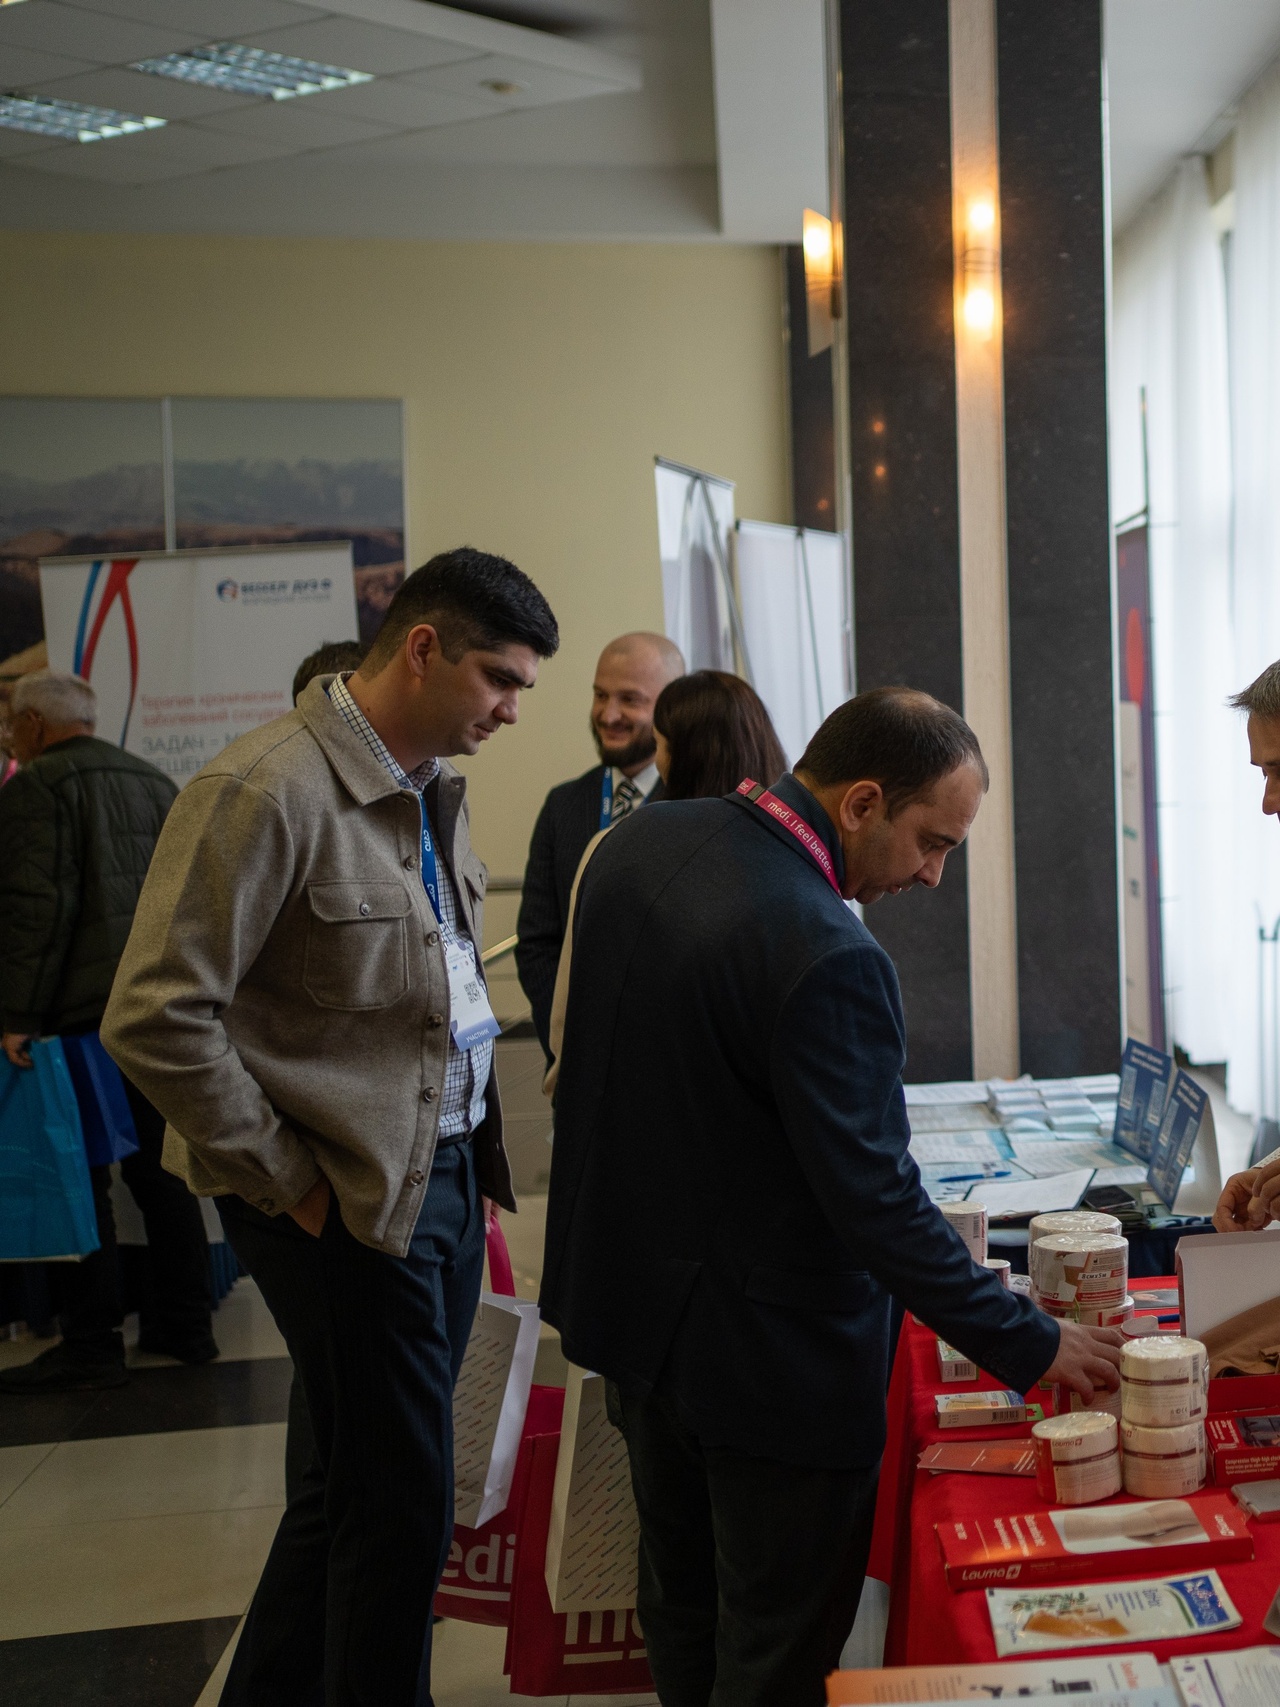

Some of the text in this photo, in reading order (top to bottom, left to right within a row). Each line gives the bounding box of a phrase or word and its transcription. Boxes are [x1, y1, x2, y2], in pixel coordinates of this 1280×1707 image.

[767, 802, 792, 823] medi.
[794, 823, 814, 843] feel
[810, 840, 832, 874] better.
[466, 1027, 490, 1043] УЧАСТНИК
[962, 1568, 1005, 1581] Lauma
